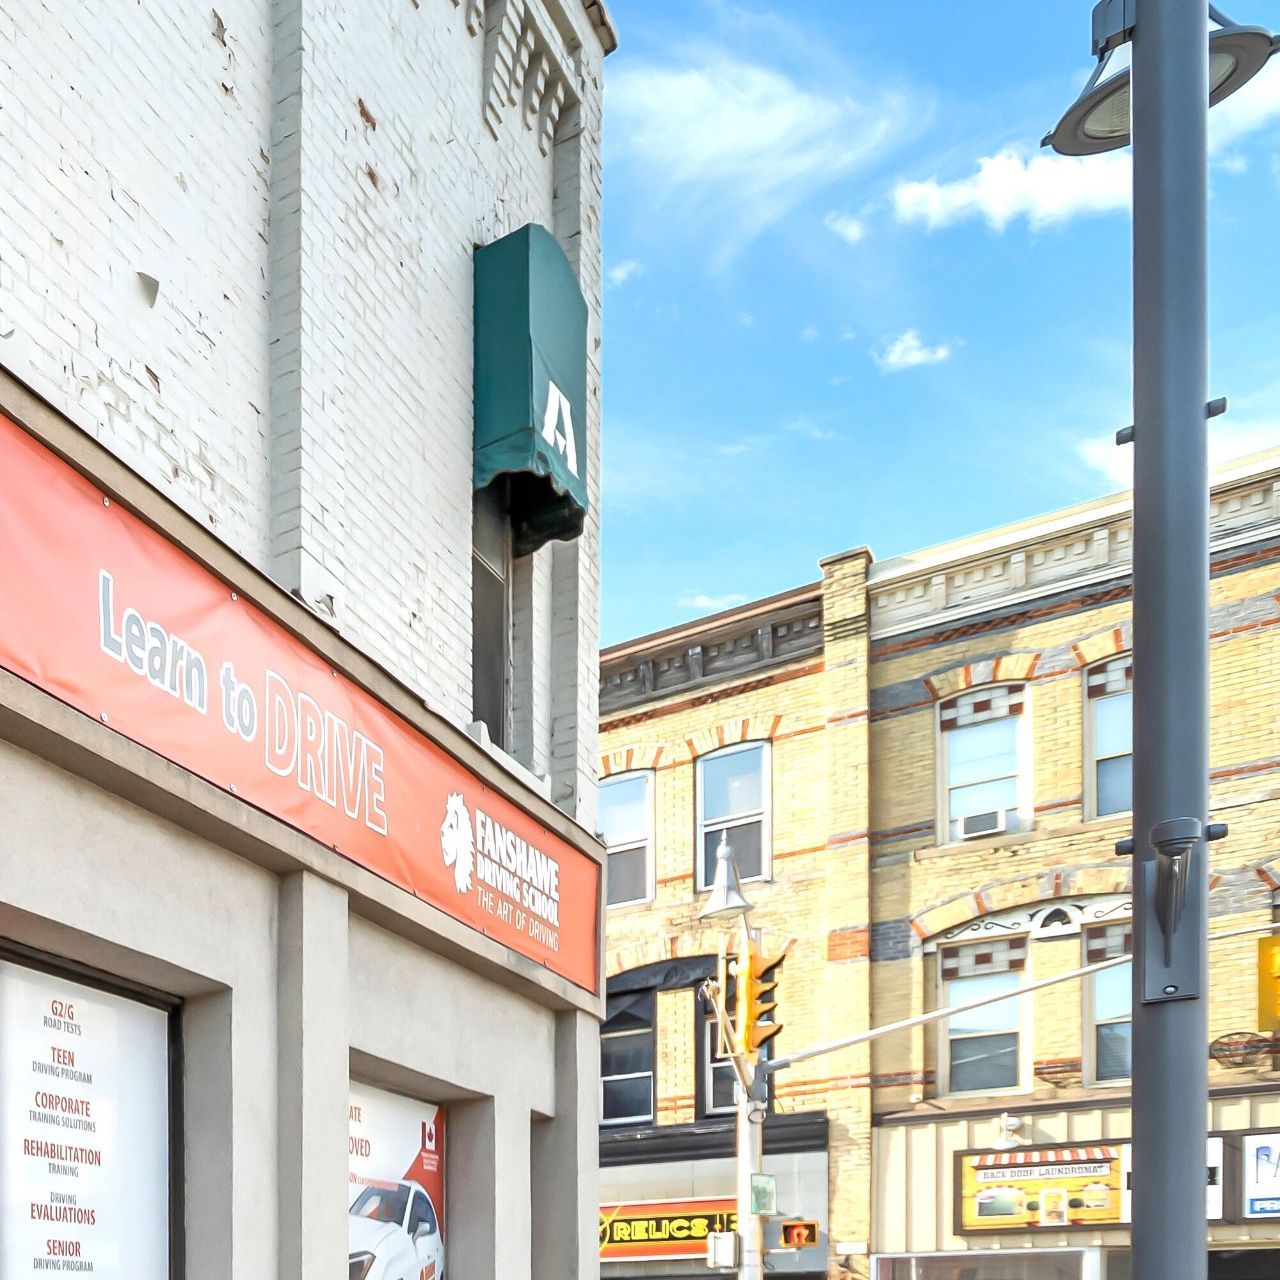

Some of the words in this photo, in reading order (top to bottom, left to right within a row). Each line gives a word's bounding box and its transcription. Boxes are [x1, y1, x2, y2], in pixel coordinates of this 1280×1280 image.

[98, 568, 208, 716] Learn
[219, 661, 258, 743] to
[264, 668, 389, 838] DRIVE
[475, 807, 561, 903] FANSHAWE
[476, 851, 521, 904] DRIVING
[522, 880, 560, 928] SCHOOL
[476, 885, 494, 916] THE
[496, 899, 514, 925] ART
[515, 909, 527, 932] OF
[528, 916, 560, 953] DRIVING
[51, 999, 75, 1021] G2/G
[43, 1015, 62, 1031] ROAD
[63, 1021, 82, 1036] TESTS
[51, 1046, 75, 1068] TEEN
[32, 1060, 60, 1078] DRIVING
[60, 1067, 93, 1085] PROGRAM
[34, 1091, 91, 1118] CORPORATE
[28, 1109, 61, 1127] TRAINING
[61, 1116, 97, 1133] SOLUTIONS
[23, 1138, 101, 1167] REHABILITATION
[47, 1162, 79, 1178] TRAINING
[983, 1170, 1007, 1179] BACK
[1010, 1168, 1035, 1178] DOOR
[1038, 1164, 1105, 1176] LAUNDROMAT
[49, 1191, 77, 1206] DRIVING
[30, 1202, 96, 1226] EVALUATIONS
[613, 1218, 709, 1241] RELICS
[46, 1239, 81, 1257] SENIOR
[33, 1257, 61, 1271] DRIVING
[61, 1260, 94, 1272] PROGRAM
